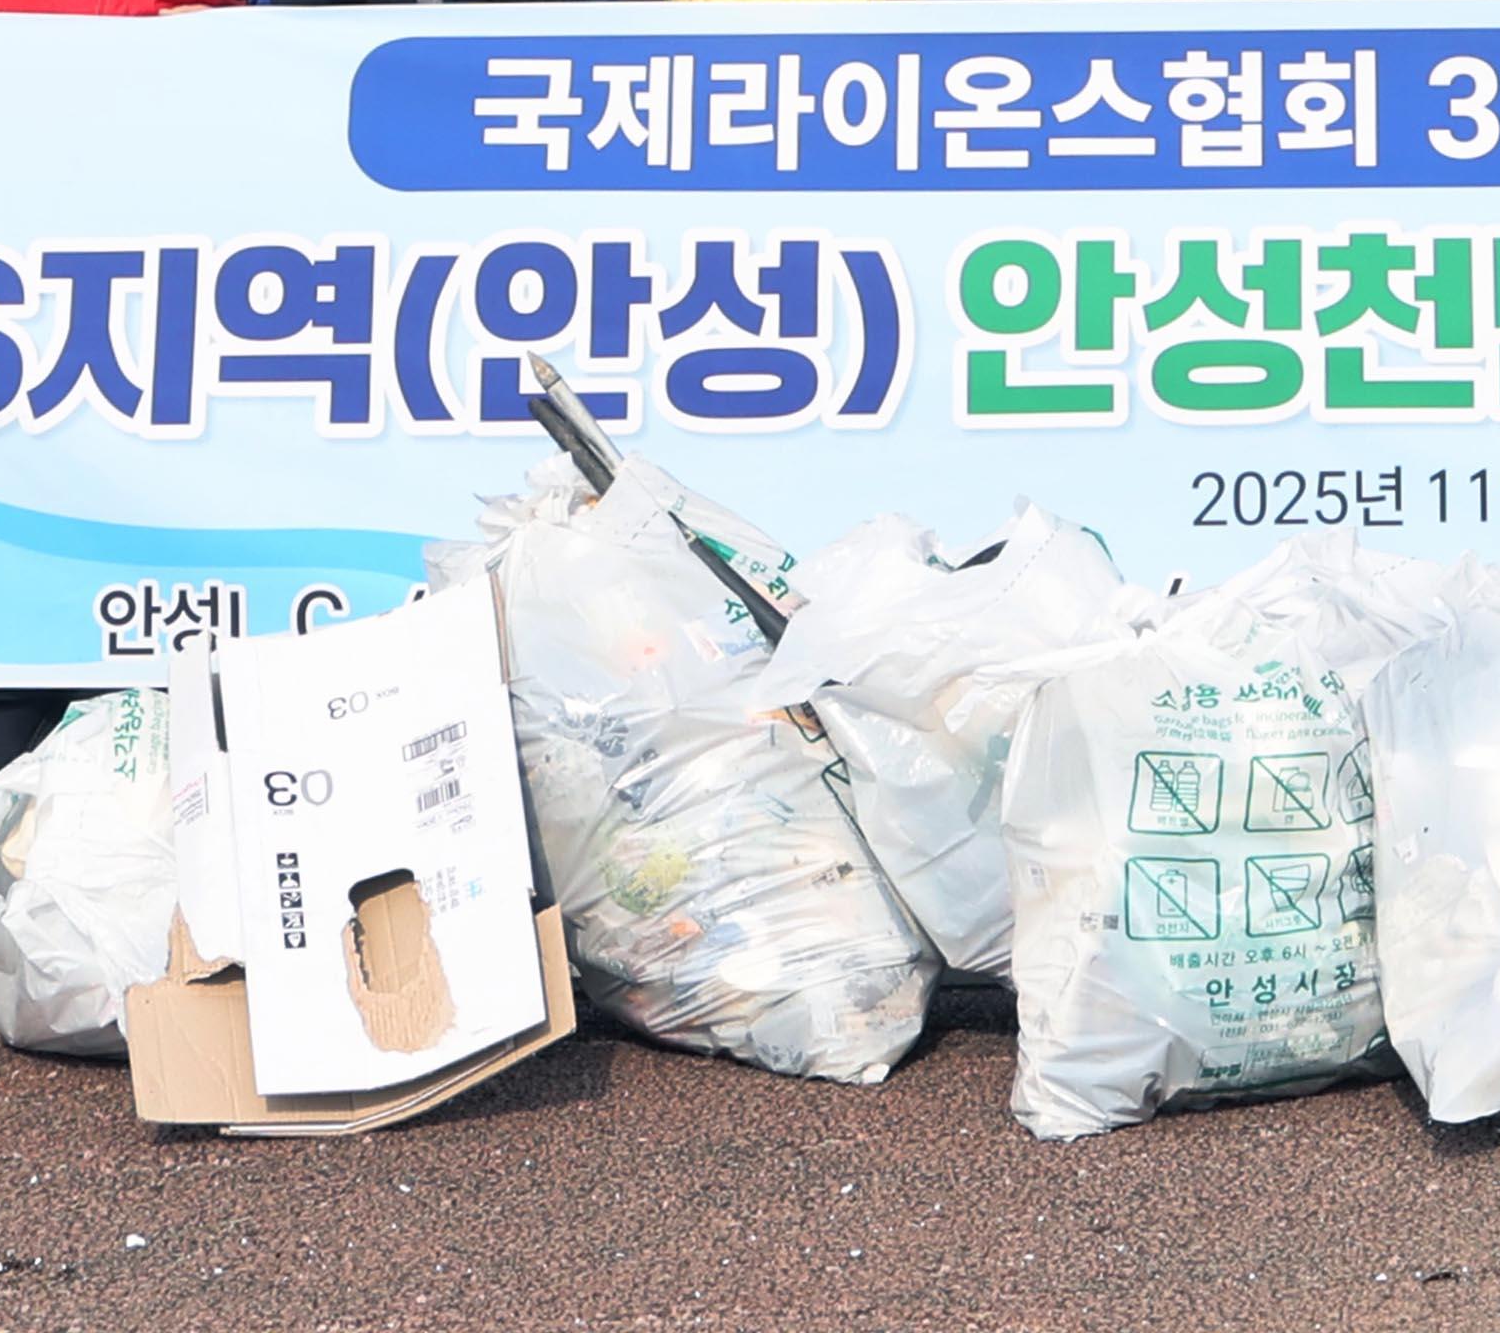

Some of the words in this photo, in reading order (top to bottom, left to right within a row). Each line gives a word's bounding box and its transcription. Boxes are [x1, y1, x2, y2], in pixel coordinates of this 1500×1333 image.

[474, 49, 1377, 171] 국제라이온스협회
[1192, 465, 1404, 526] 2025년
[263, 768, 333, 809] 03
[1169, 952, 1236, 970] 배출시간
[1244, 946, 1275, 965] 오후
[1281, 944, 1307, 961] 6시
